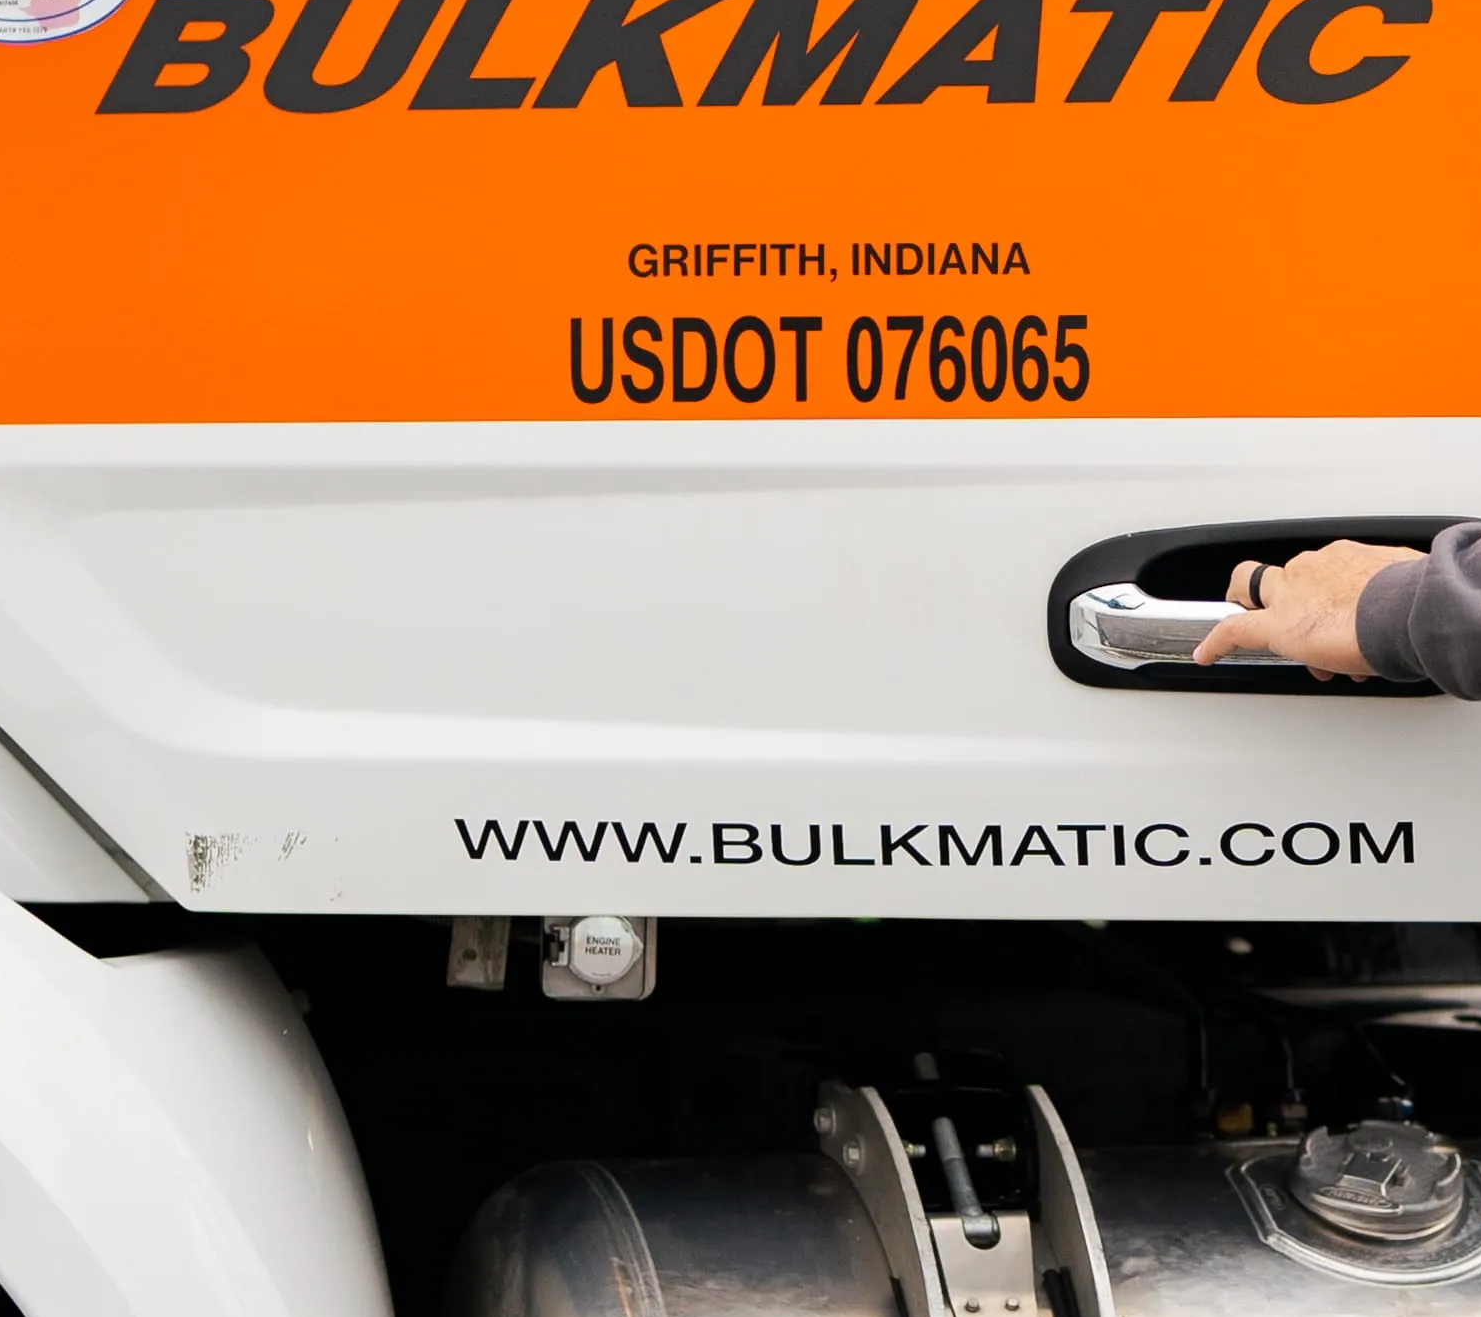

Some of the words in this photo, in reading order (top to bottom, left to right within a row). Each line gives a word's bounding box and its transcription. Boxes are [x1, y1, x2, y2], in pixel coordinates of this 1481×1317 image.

[628, 243, 838, 283] GRIFFITH,
[851, 242, 1031, 277] INDIANA
[569, 316, 823, 404] USDOT
[845, 313, 1090, 403] 076065
[454, 818, 1416, 867] WWW.BULKMATIC.COM
[584, 946, 622, 956] HEATER
[586, 936, 622, 946] ENGINE
